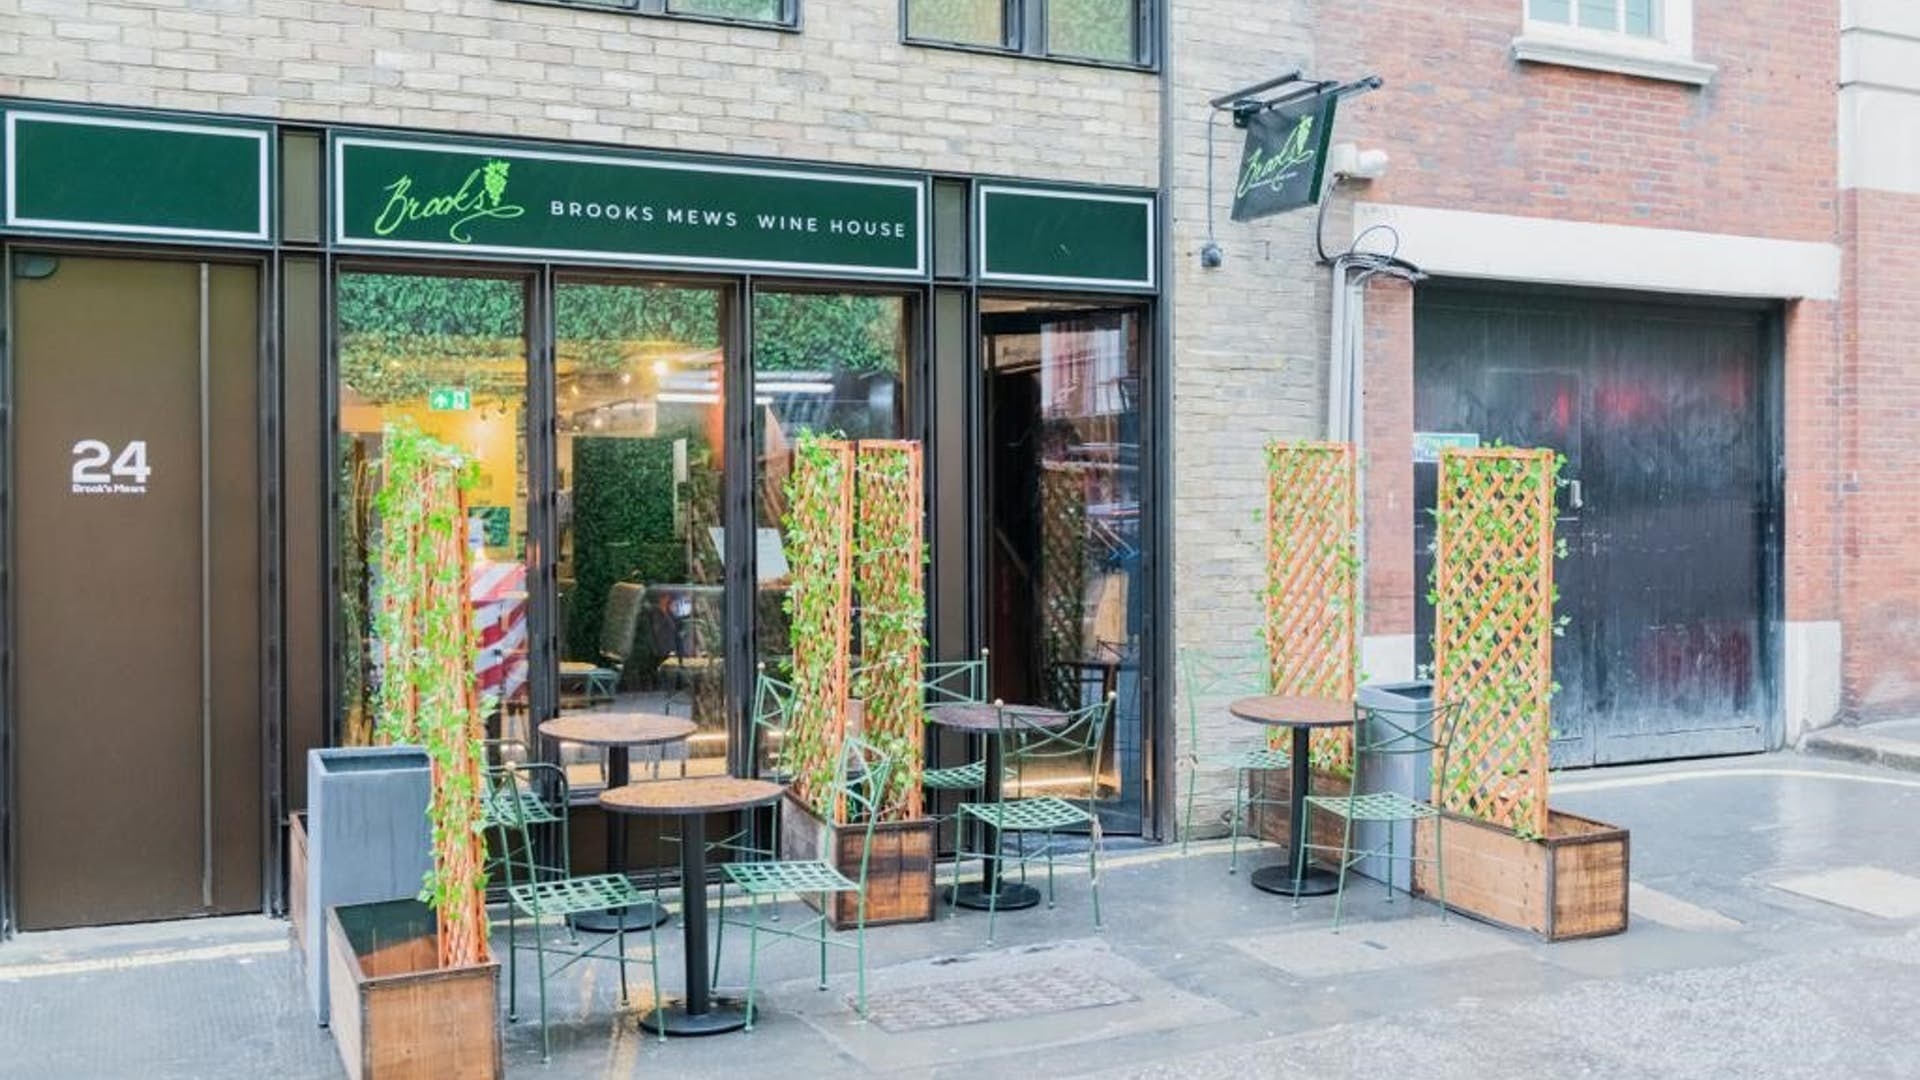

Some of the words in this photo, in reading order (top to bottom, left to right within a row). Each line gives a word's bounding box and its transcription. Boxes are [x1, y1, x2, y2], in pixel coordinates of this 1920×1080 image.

[374, 168, 525, 243] Brooks
[550, 200, 654, 221] BROOKS
[667, 209, 738, 227] MEWS
[757, 214, 818, 232] WINE
[830, 219, 905, 238] HOUSE
[72, 439, 151, 483] 24
